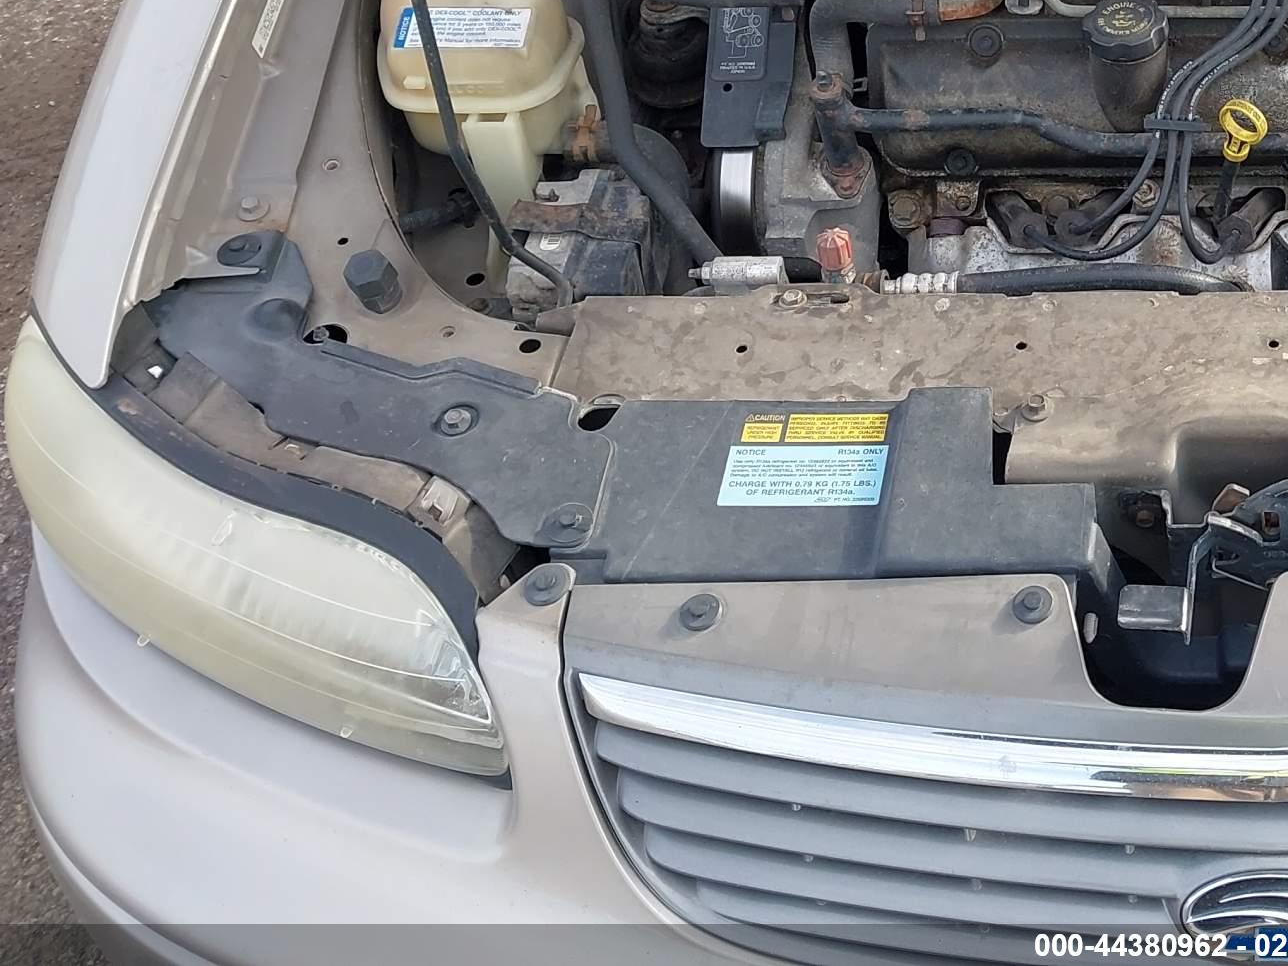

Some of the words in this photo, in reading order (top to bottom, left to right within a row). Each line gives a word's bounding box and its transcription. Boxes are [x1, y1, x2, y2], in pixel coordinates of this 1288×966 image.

[398, 16, 410, 41] NOTICE
[755, 414, 785, 422] CAUTION
[728, 480, 766, 488] CHARGE
[770, 480, 792, 488] WITH
[795, 480, 812, 488] 0.79
[816, 480, 828, 488] KG
[832, 480, 852, 488] (1.75
[853, 480, 877, 488] LBS.)
